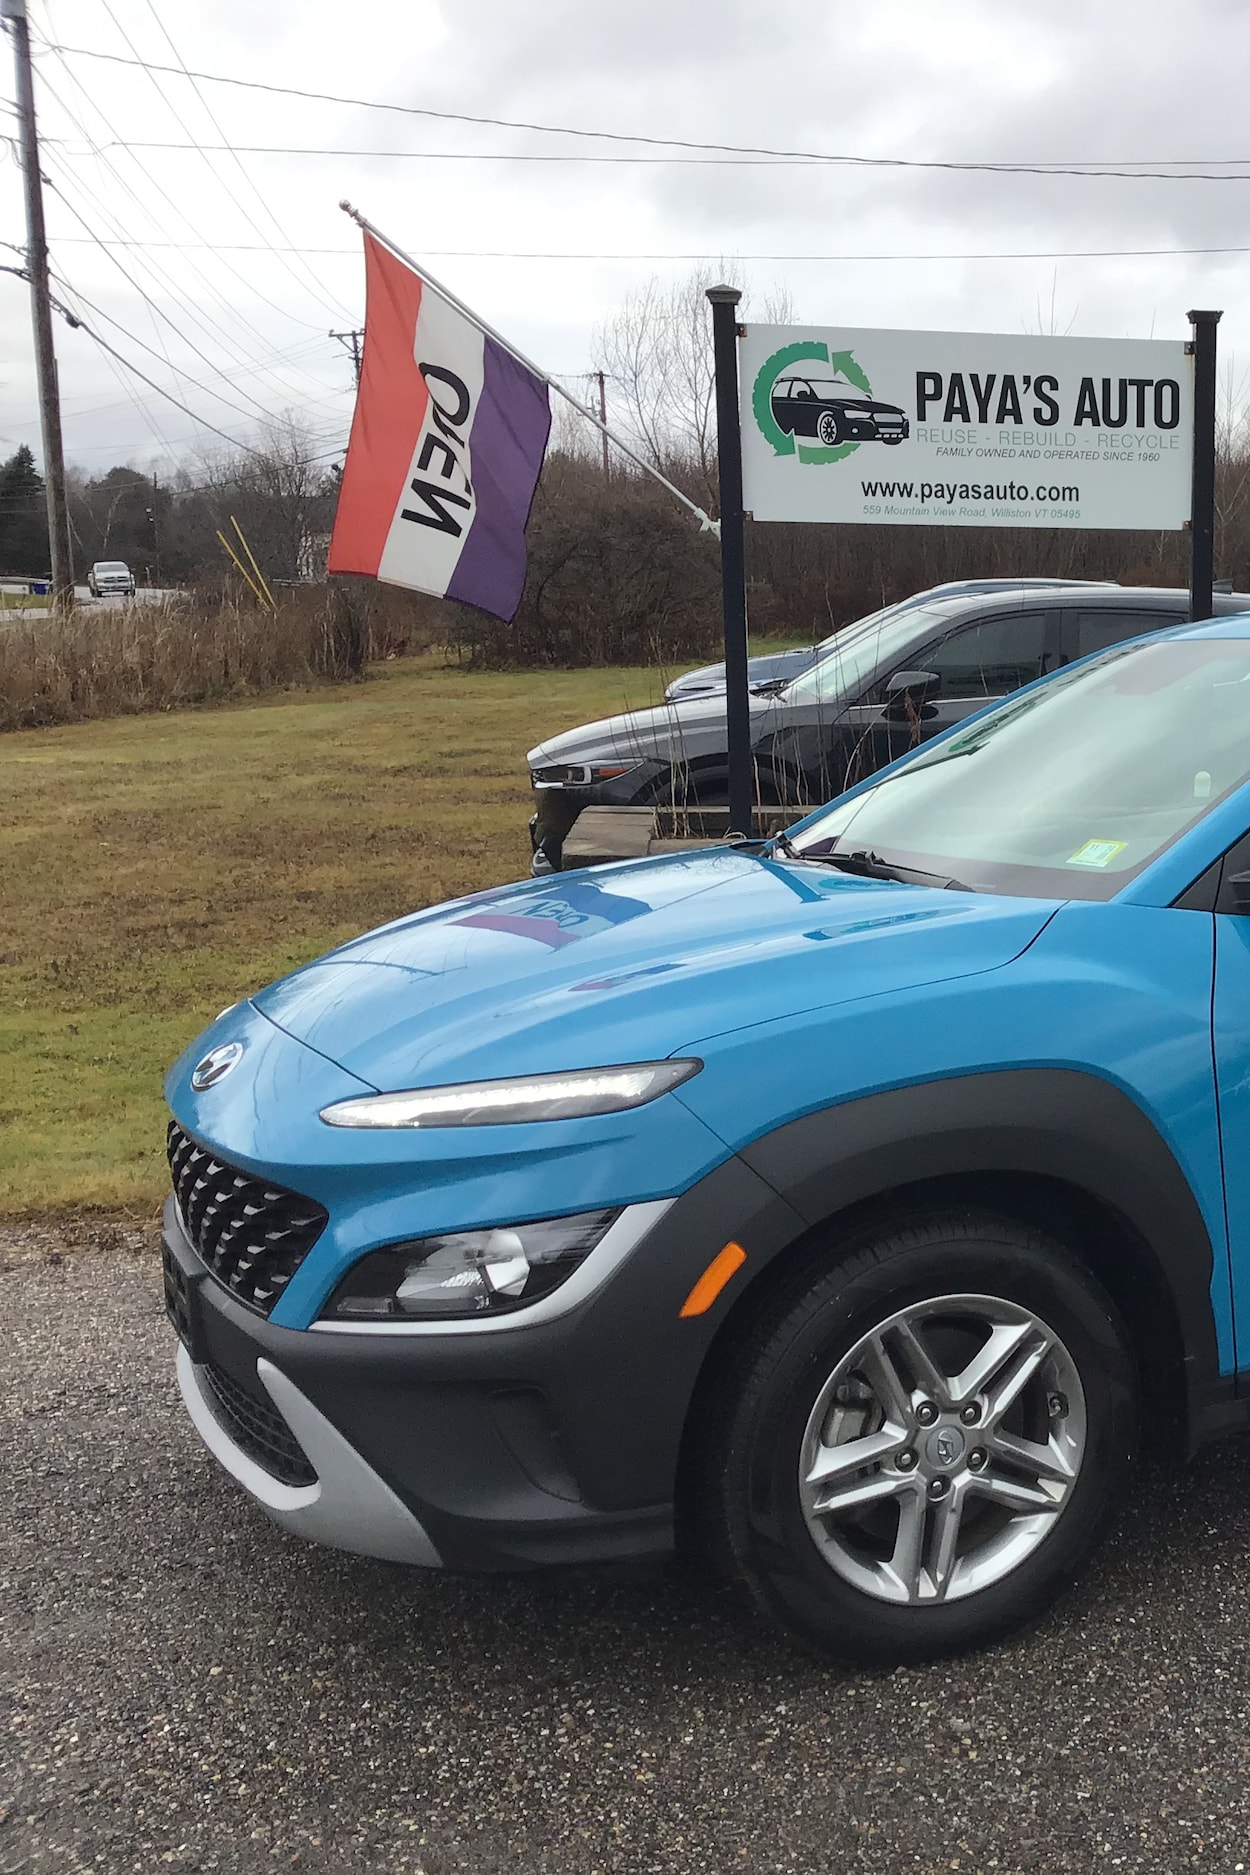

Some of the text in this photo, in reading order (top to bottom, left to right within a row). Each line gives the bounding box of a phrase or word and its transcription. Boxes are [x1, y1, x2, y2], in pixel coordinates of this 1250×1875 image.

[916, 371, 1180, 430] PAYA'S AUTO
[917, 428, 977, 444] REUSE
[999, 430, 1076, 447] REBUILD
[1097, 433, 1180, 449] RECYCLE
[936, 446, 1160, 462] FAMILY OWNED AND OPERATED SINCE 1960
[861, 481, 1080, 505] www.payasauto.com
[862, 504, 882, 515] 559
[884, 505, 930, 516] Mountain
[933, 506, 957, 517] View
[991, 508, 1031, 518] Williston
[1034, 509, 1049, 518] VT
[1050, 509, 1081, 519] 05495
